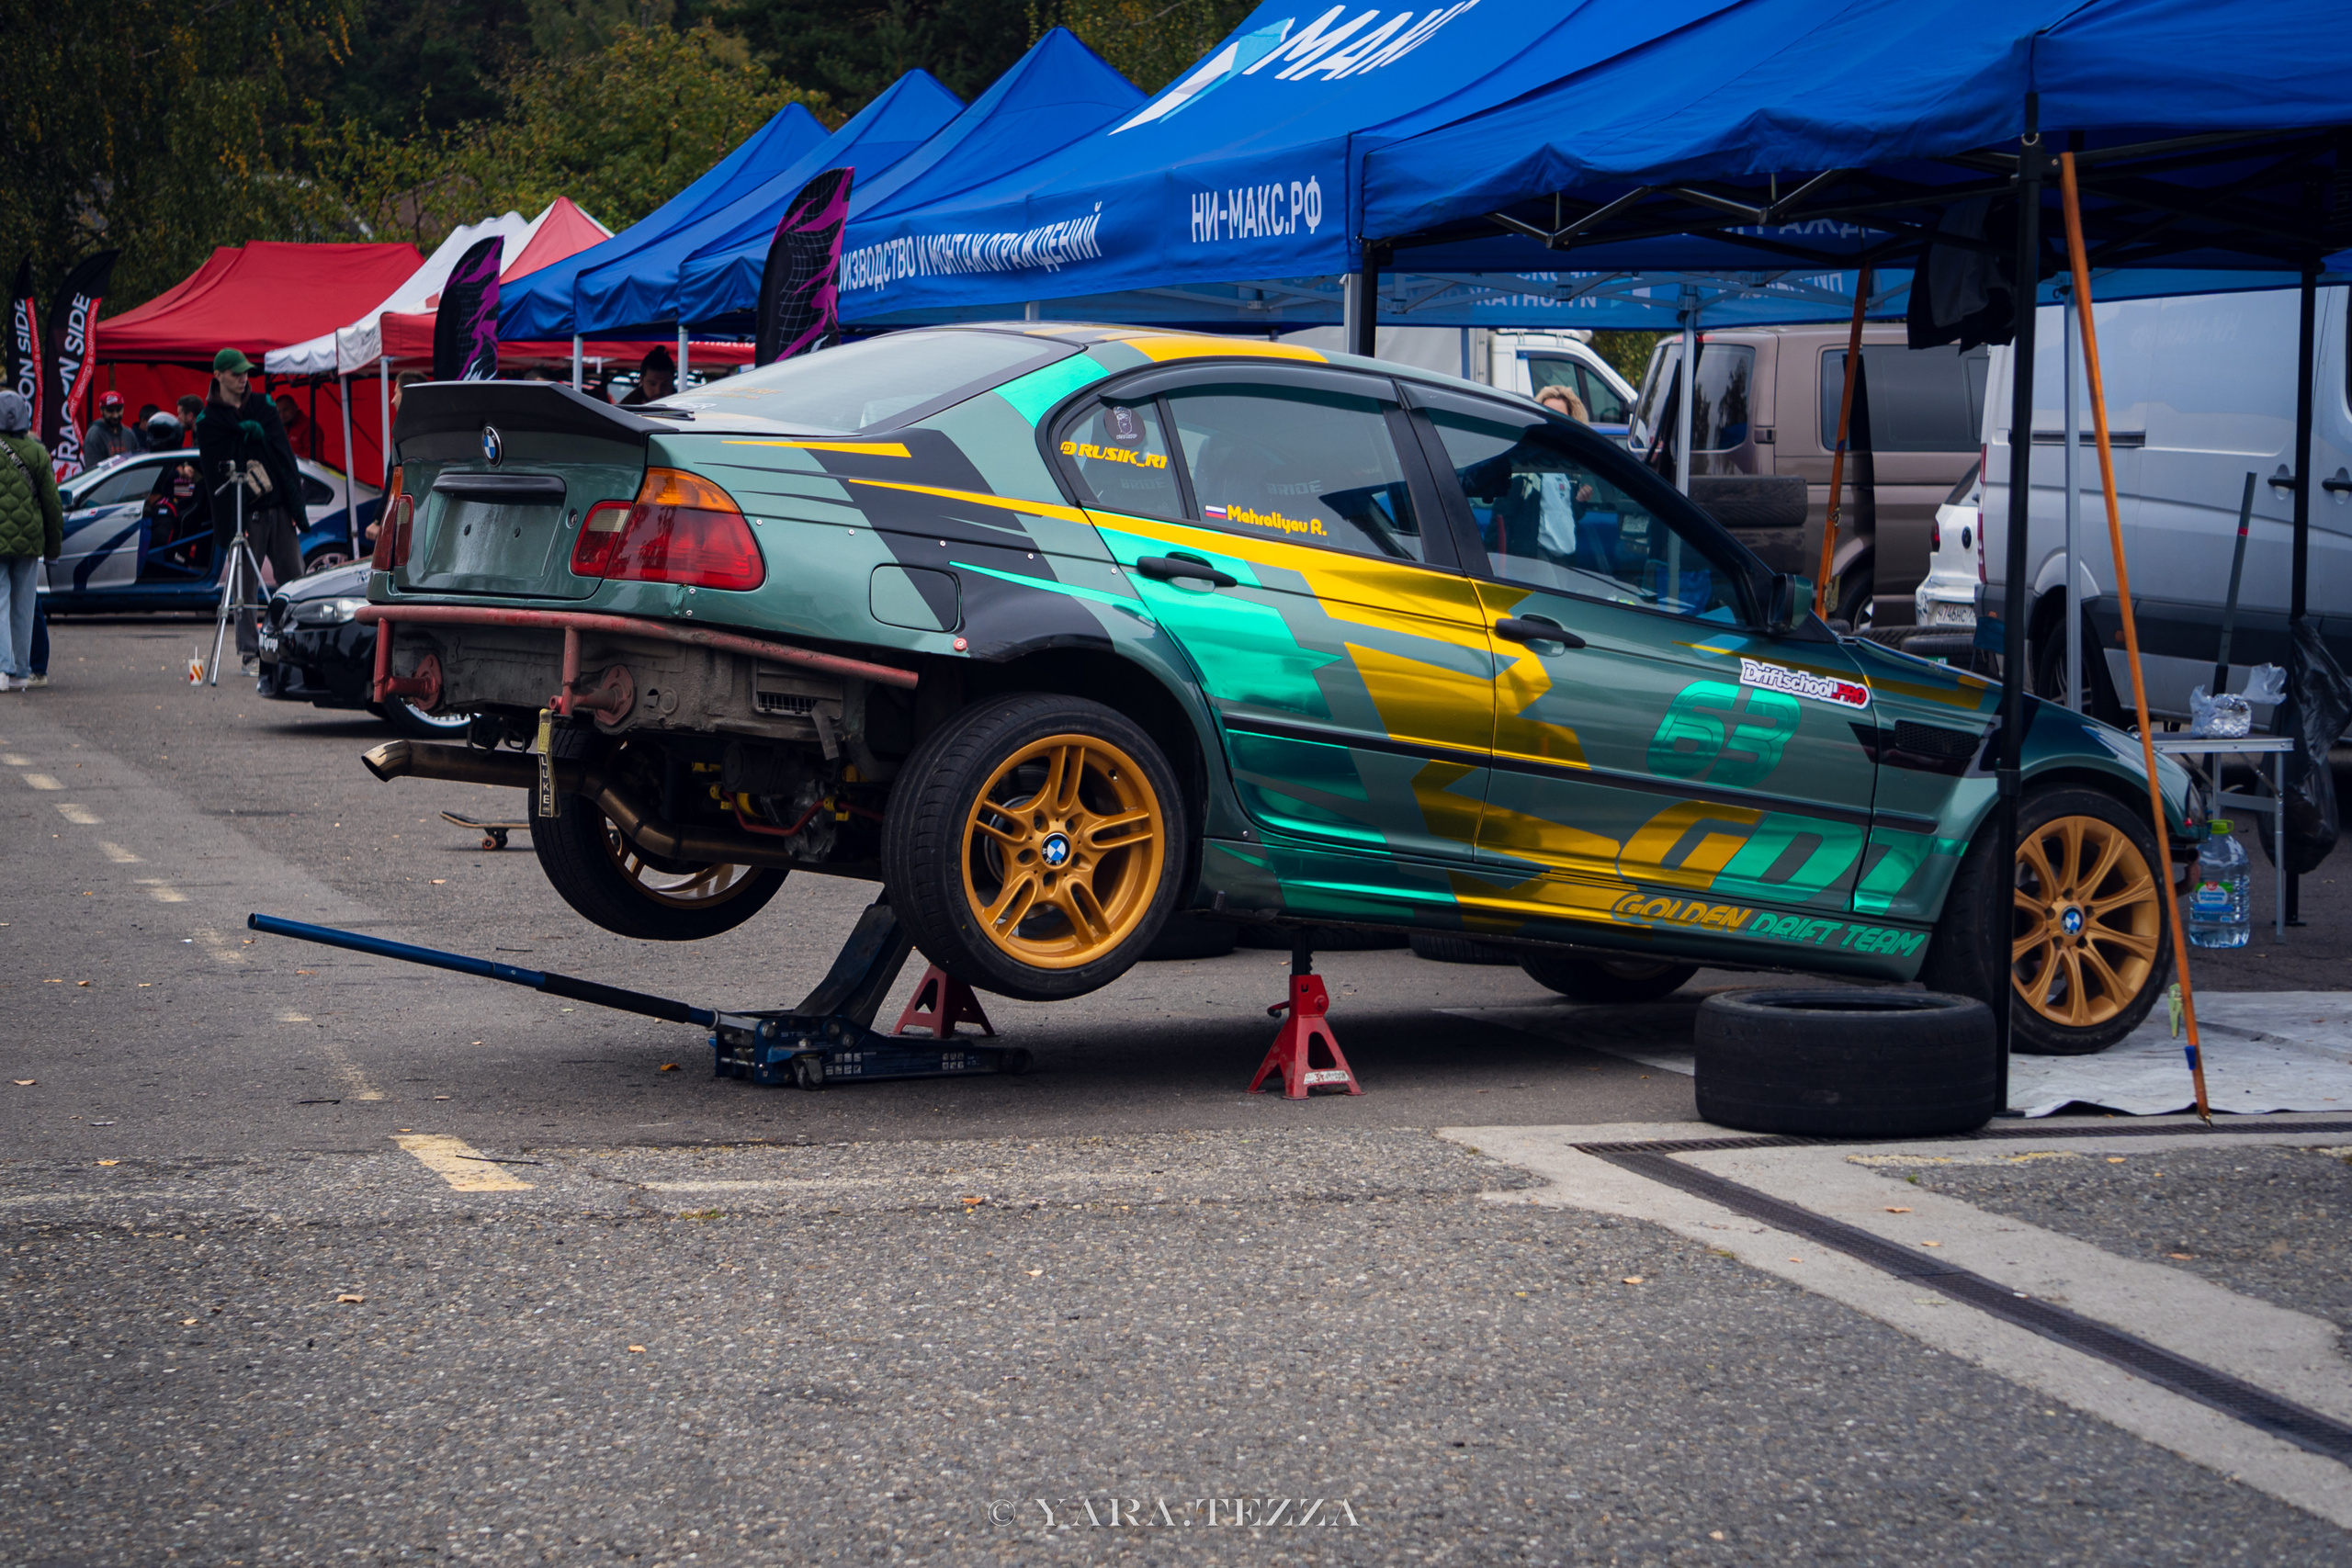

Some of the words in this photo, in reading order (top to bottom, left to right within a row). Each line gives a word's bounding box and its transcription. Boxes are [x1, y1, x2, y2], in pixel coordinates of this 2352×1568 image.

[917, 235, 931, 276] И
[927, 233, 991, 276] МОНТАЖ
[985, 201, 1102, 273] ОГРАЖДЕНИЙ
[1192, 175, 1322, 243] НИ-МАКС.РФ
[64, 292, 91, 356] SIDE
[1267, 479, 1323, 496] BRIDE
[1310, 518, 1328, 536] R.
[1646, 680, 1802, 789] 63
[540, 756, 551, 804] LUKE
[1612, 892, 1752, 931] GOLDEN
[1747, 912, 1843, 945] DRIFT
[1838, 924, 1926, 956] TEAM
